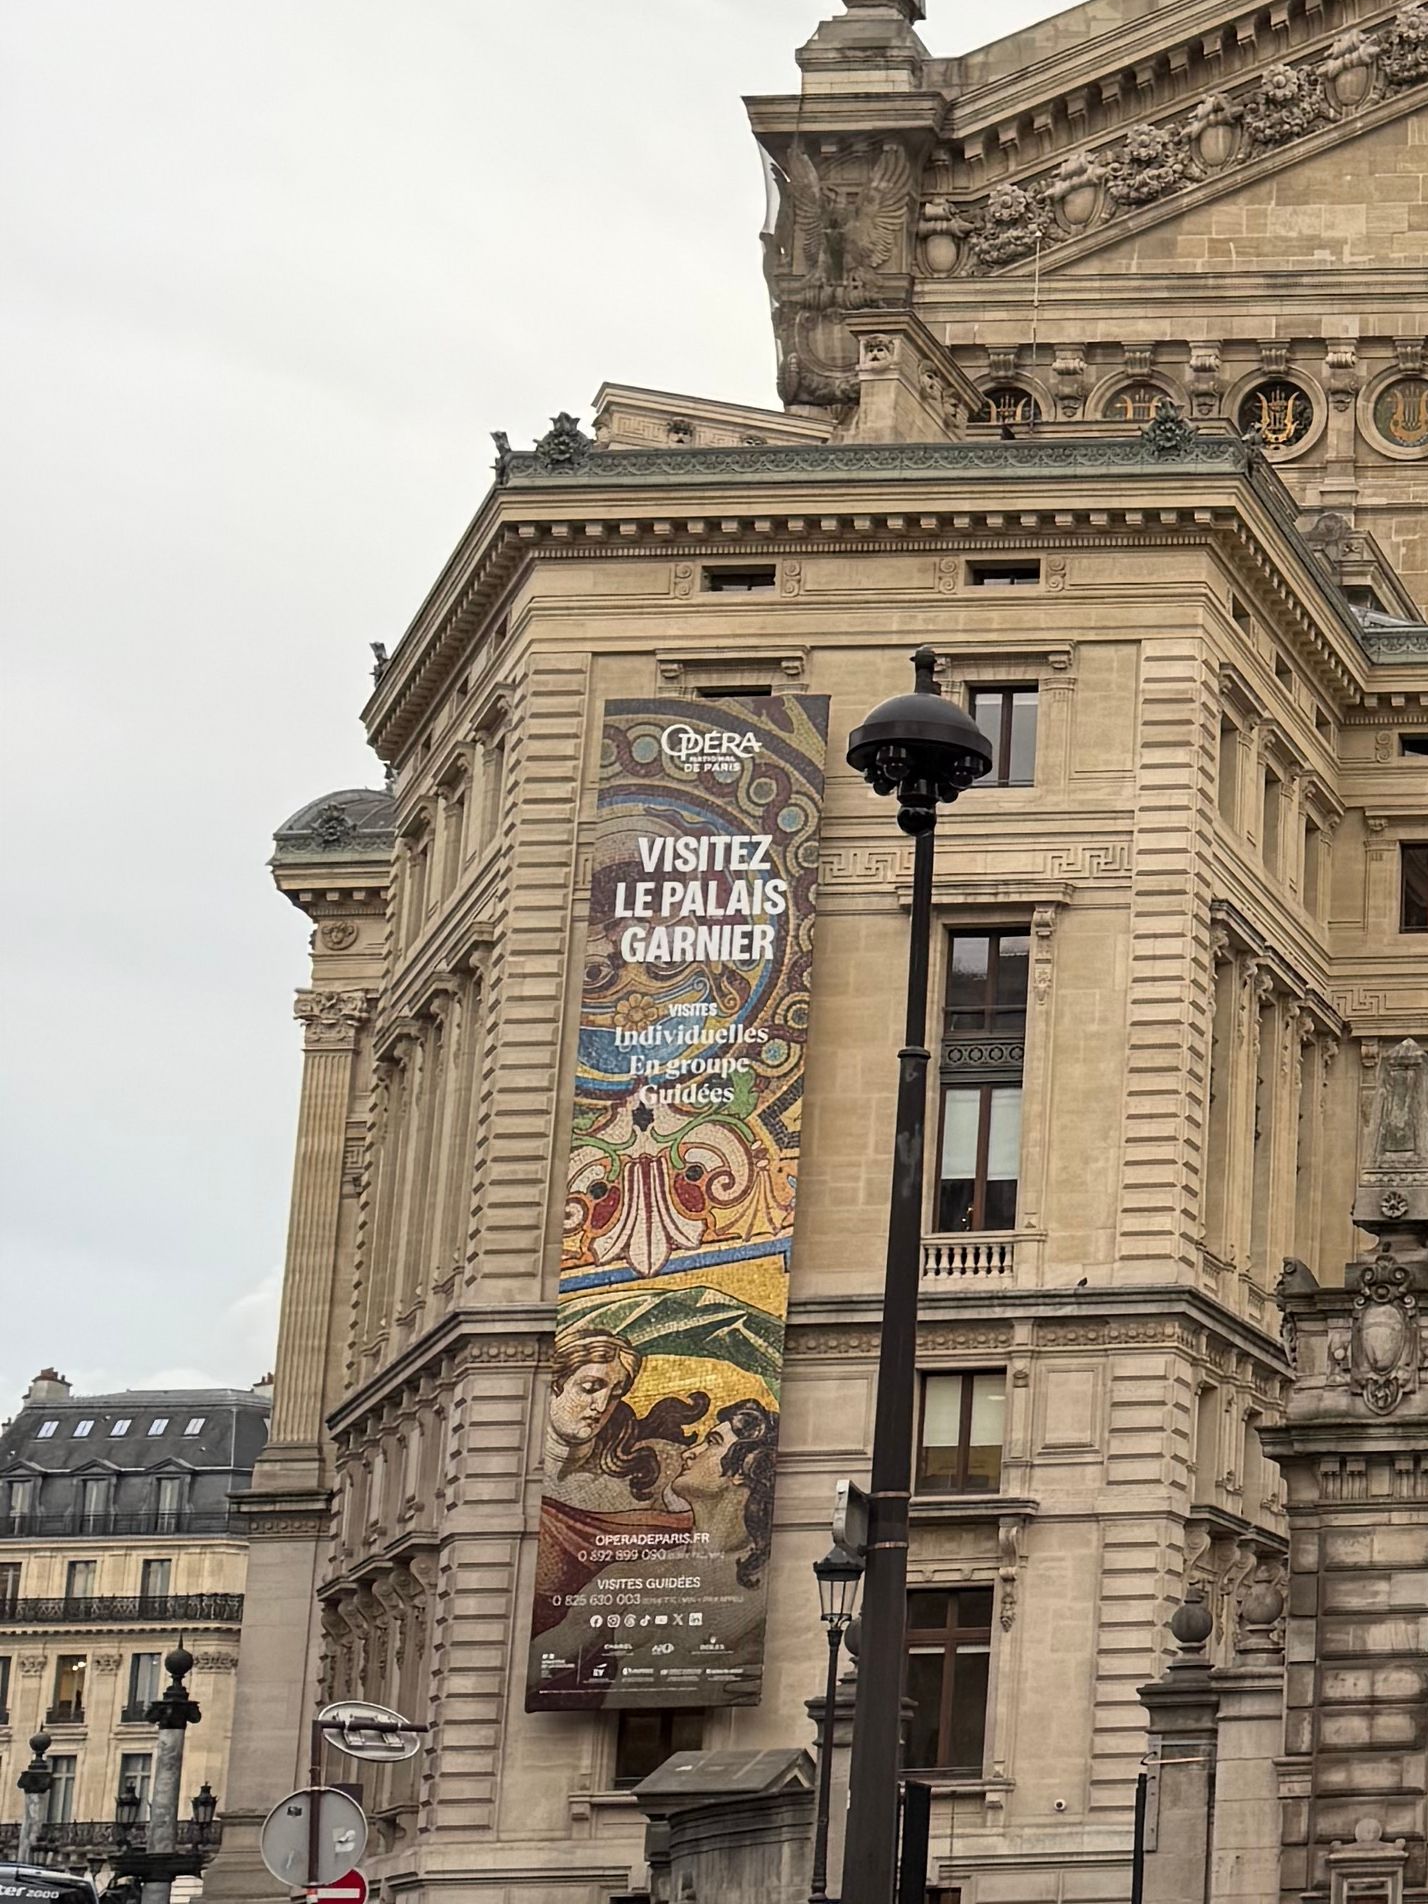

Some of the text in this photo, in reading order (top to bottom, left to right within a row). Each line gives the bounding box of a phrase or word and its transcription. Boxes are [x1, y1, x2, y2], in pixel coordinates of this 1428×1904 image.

[661, 724, 762, 761] OPÉRA
[684, 762, 740, 772] DE PARIS
[638, 835, 773, 872] VISITEZ
[615, 879, 787, 918] LE PALAIS
[621, 924, 775, 962] GARNIER
[668, 1003, 717, 1017] VISITES
[614, 1024, 769, 1046] Individuelles
[630, 1055, 750, 1079] En groupe
[639, 1084, 734, 1107] Guidées
[595, 1533, 710, 1546] OPERADEPARIS.FR
[615, 1549, 638, 1561] 899
[642, 1549, 666, 1560] 090
[597, 1575, 701, 1590] VISITES GUIDÉES
[565, 1595, 587, 1606] 825
[590, 1594, 613, 1605] 630
[617, 1594, 641, 1605] 003
